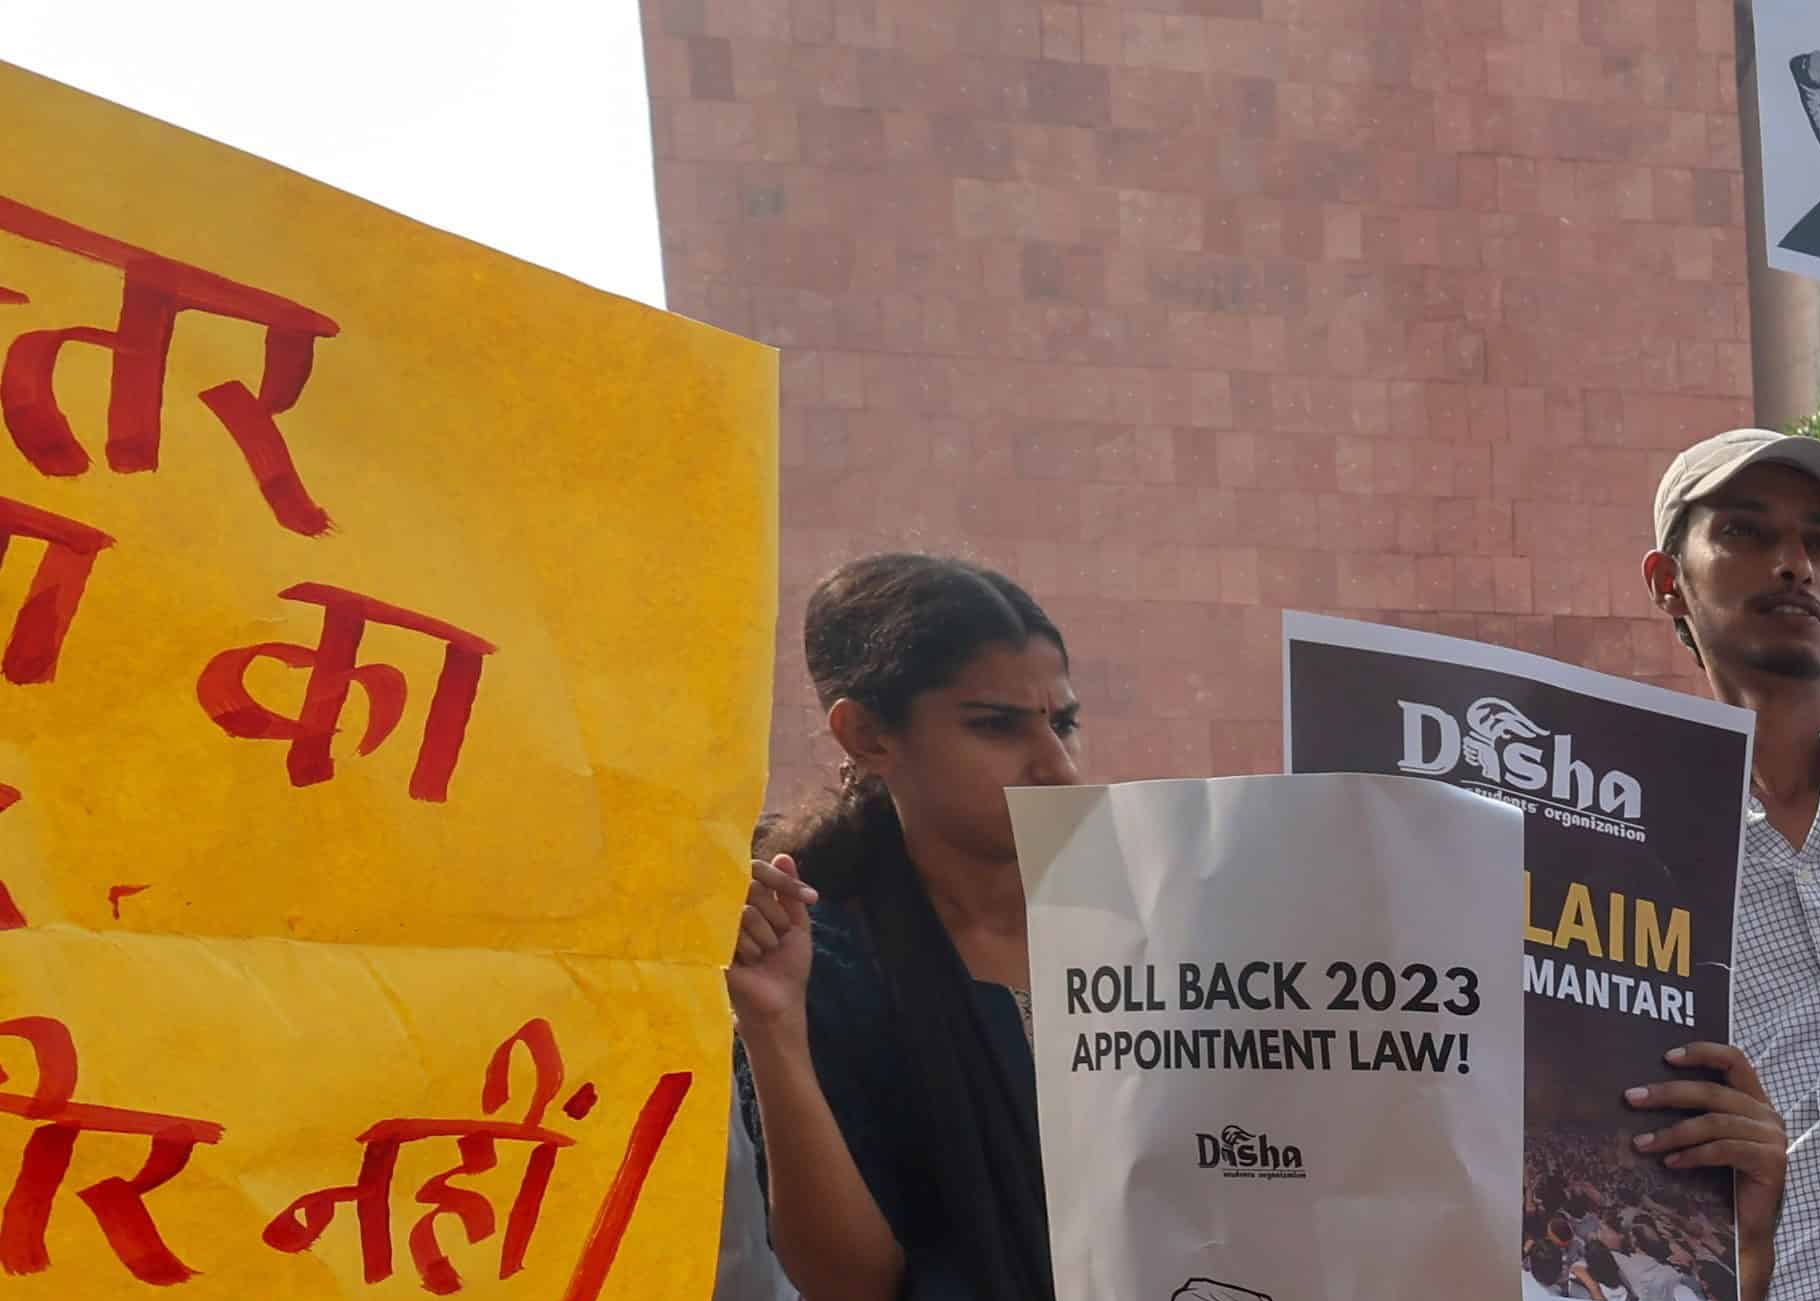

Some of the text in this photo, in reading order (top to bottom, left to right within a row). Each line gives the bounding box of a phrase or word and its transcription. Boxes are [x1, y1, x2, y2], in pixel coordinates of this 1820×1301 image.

[197, 582, 498, 804] का
[1397, 696, 1644, 819] Disha
[1543, 805, 1647, 843] organization
[1523, 870, 1691, 977] LAIM
[1066, 961, 1481, 1017] ROLL BACK 2023
[1523, 954, 1695, 1027] MANTAR!
[1071, 1029, 1471, 1076] APPOINTMENT LAW!
[1195, 1125, 1303, 1171] Disha
